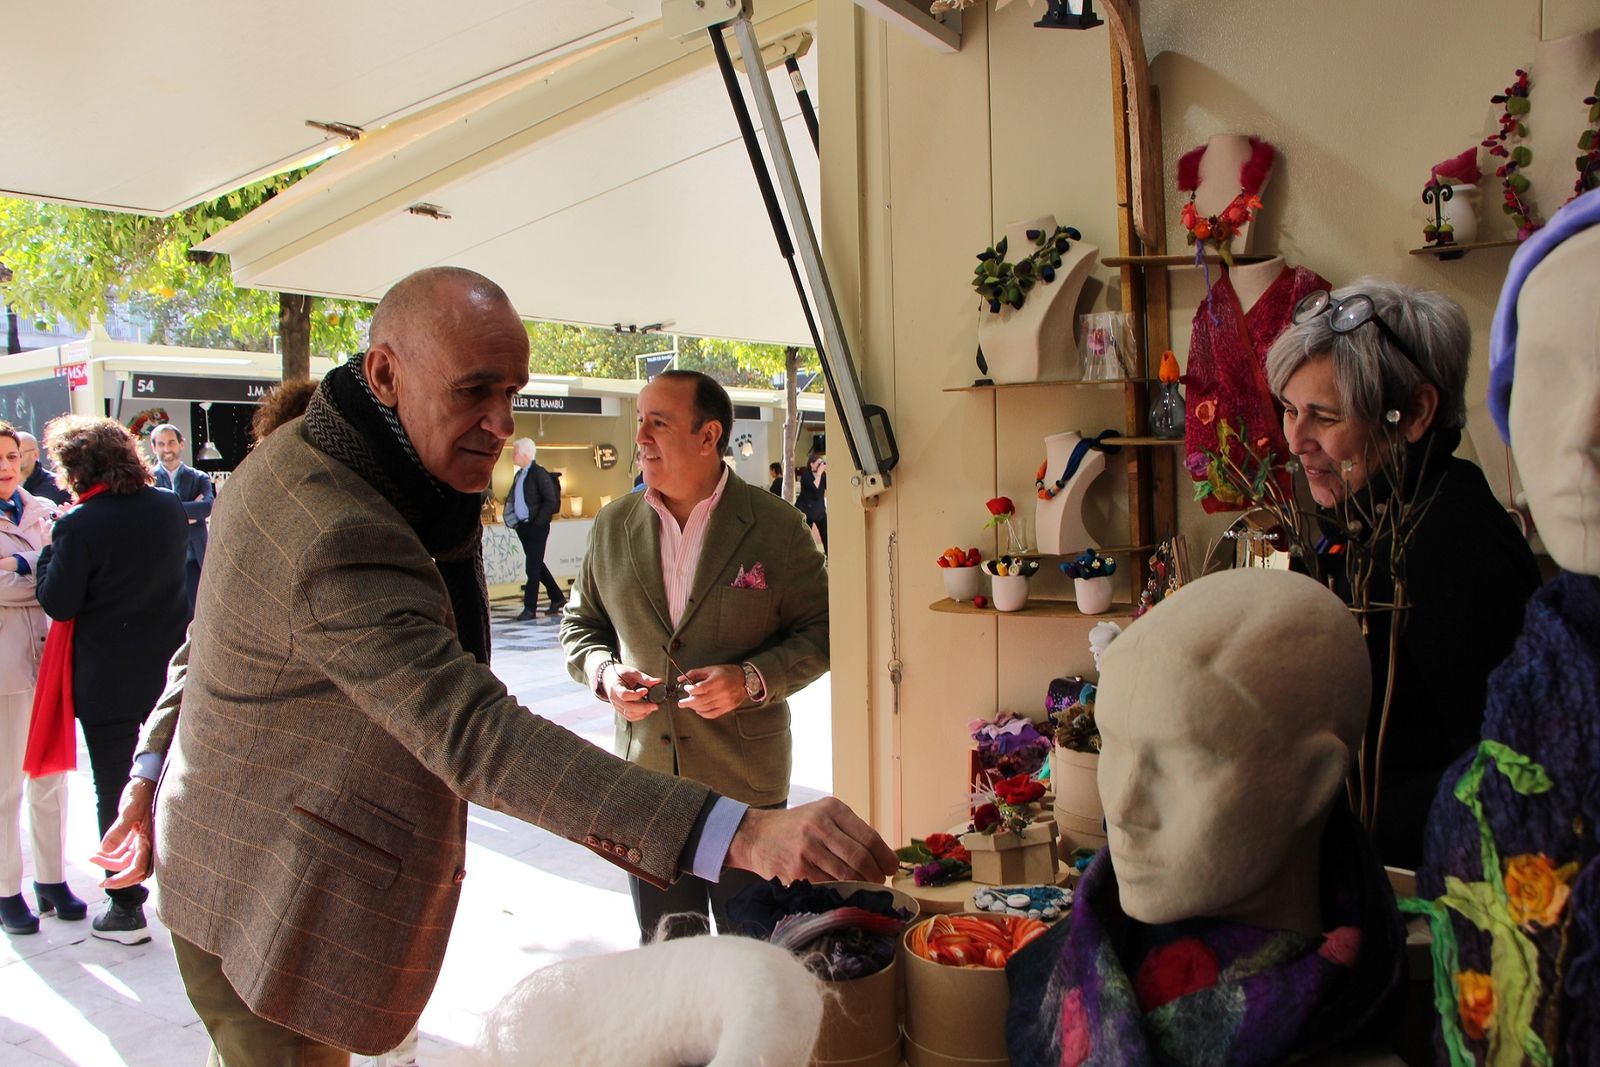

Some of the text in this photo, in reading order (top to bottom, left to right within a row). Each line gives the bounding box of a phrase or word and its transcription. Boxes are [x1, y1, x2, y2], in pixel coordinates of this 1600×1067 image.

[137, 379, 155, 393] 54
[512, 397, 564, 410] LLER DE BAMBÚ
